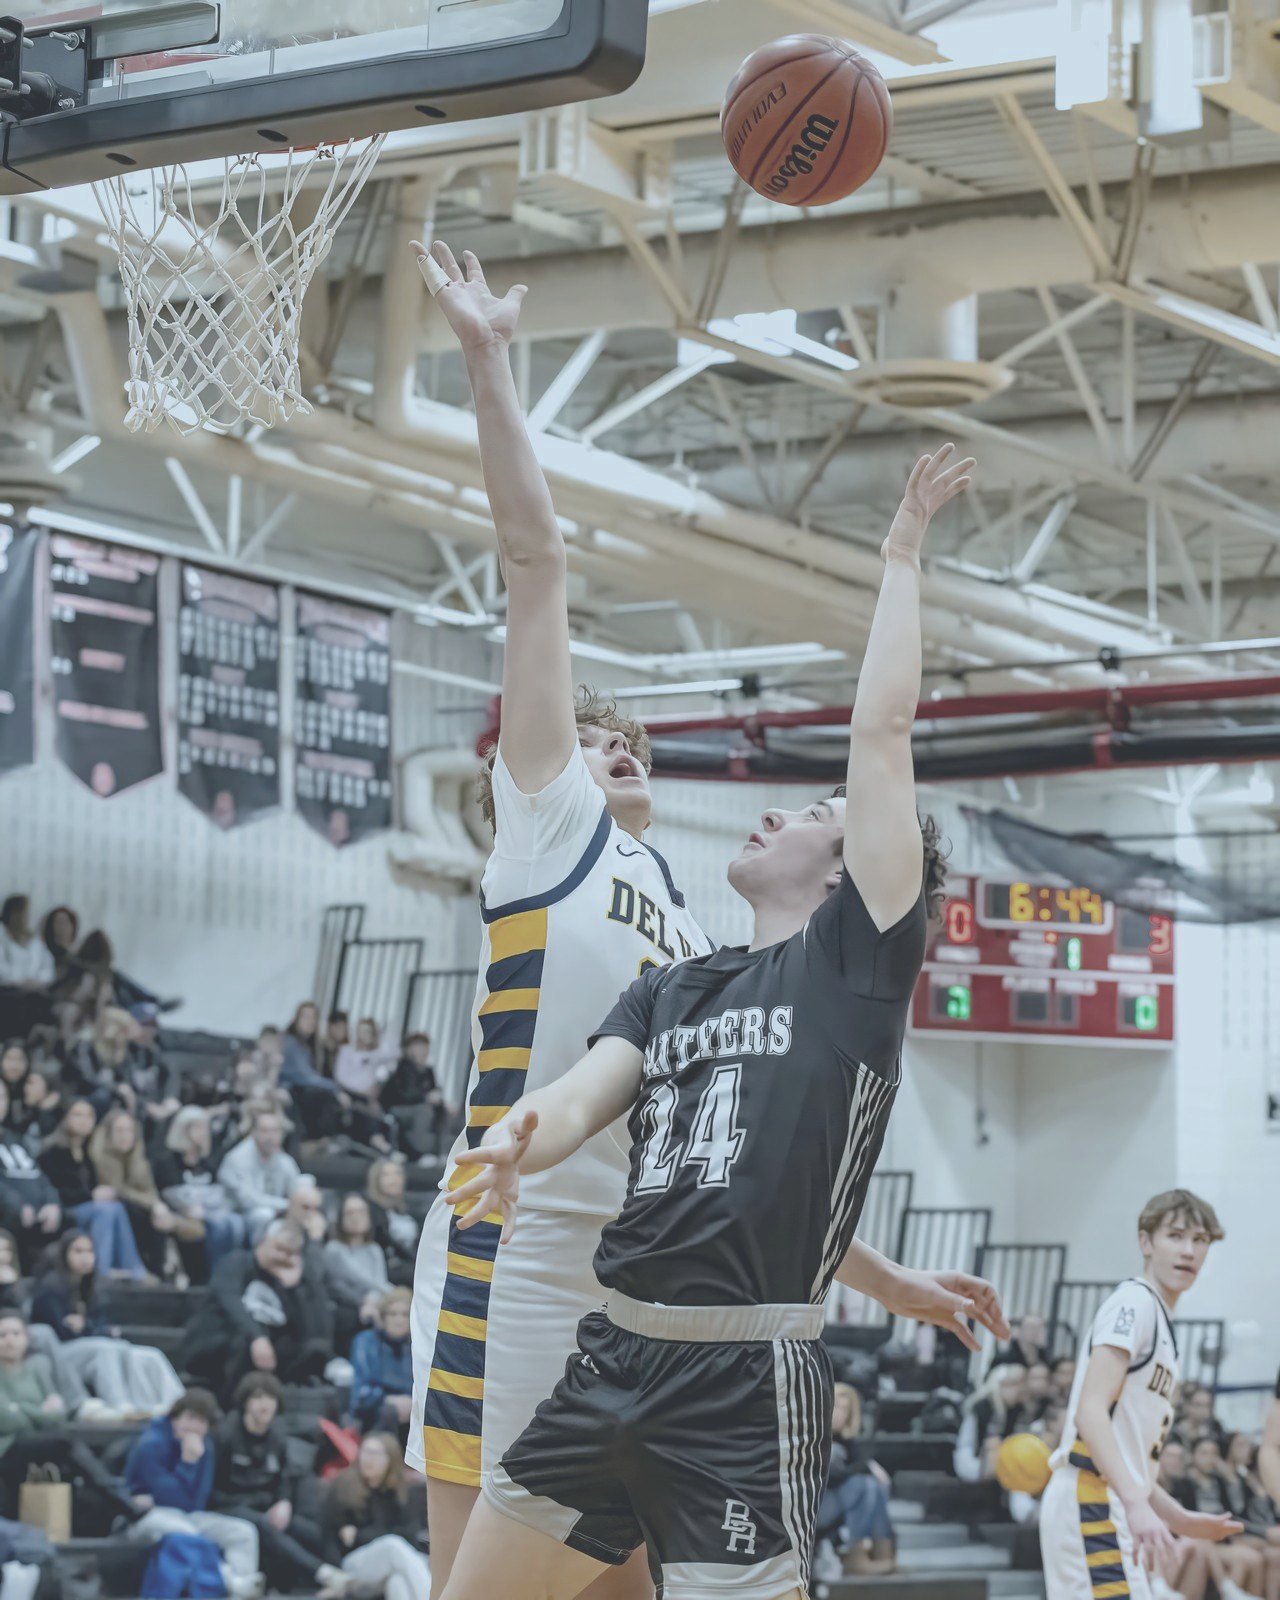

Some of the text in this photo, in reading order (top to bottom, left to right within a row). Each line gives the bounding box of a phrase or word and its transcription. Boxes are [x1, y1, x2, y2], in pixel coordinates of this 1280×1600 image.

[763, 113, 840, 196] Wilson
[946, 901, 974, 944] 0
[1009, 882, 1103, 925] 6:44
[1148, 914, 1174, 954] 3
[1135, 995, 1158, 1031] 0
[633, 1062, 748, 1198] 24
[721, 1498, 757, 1555] BR
